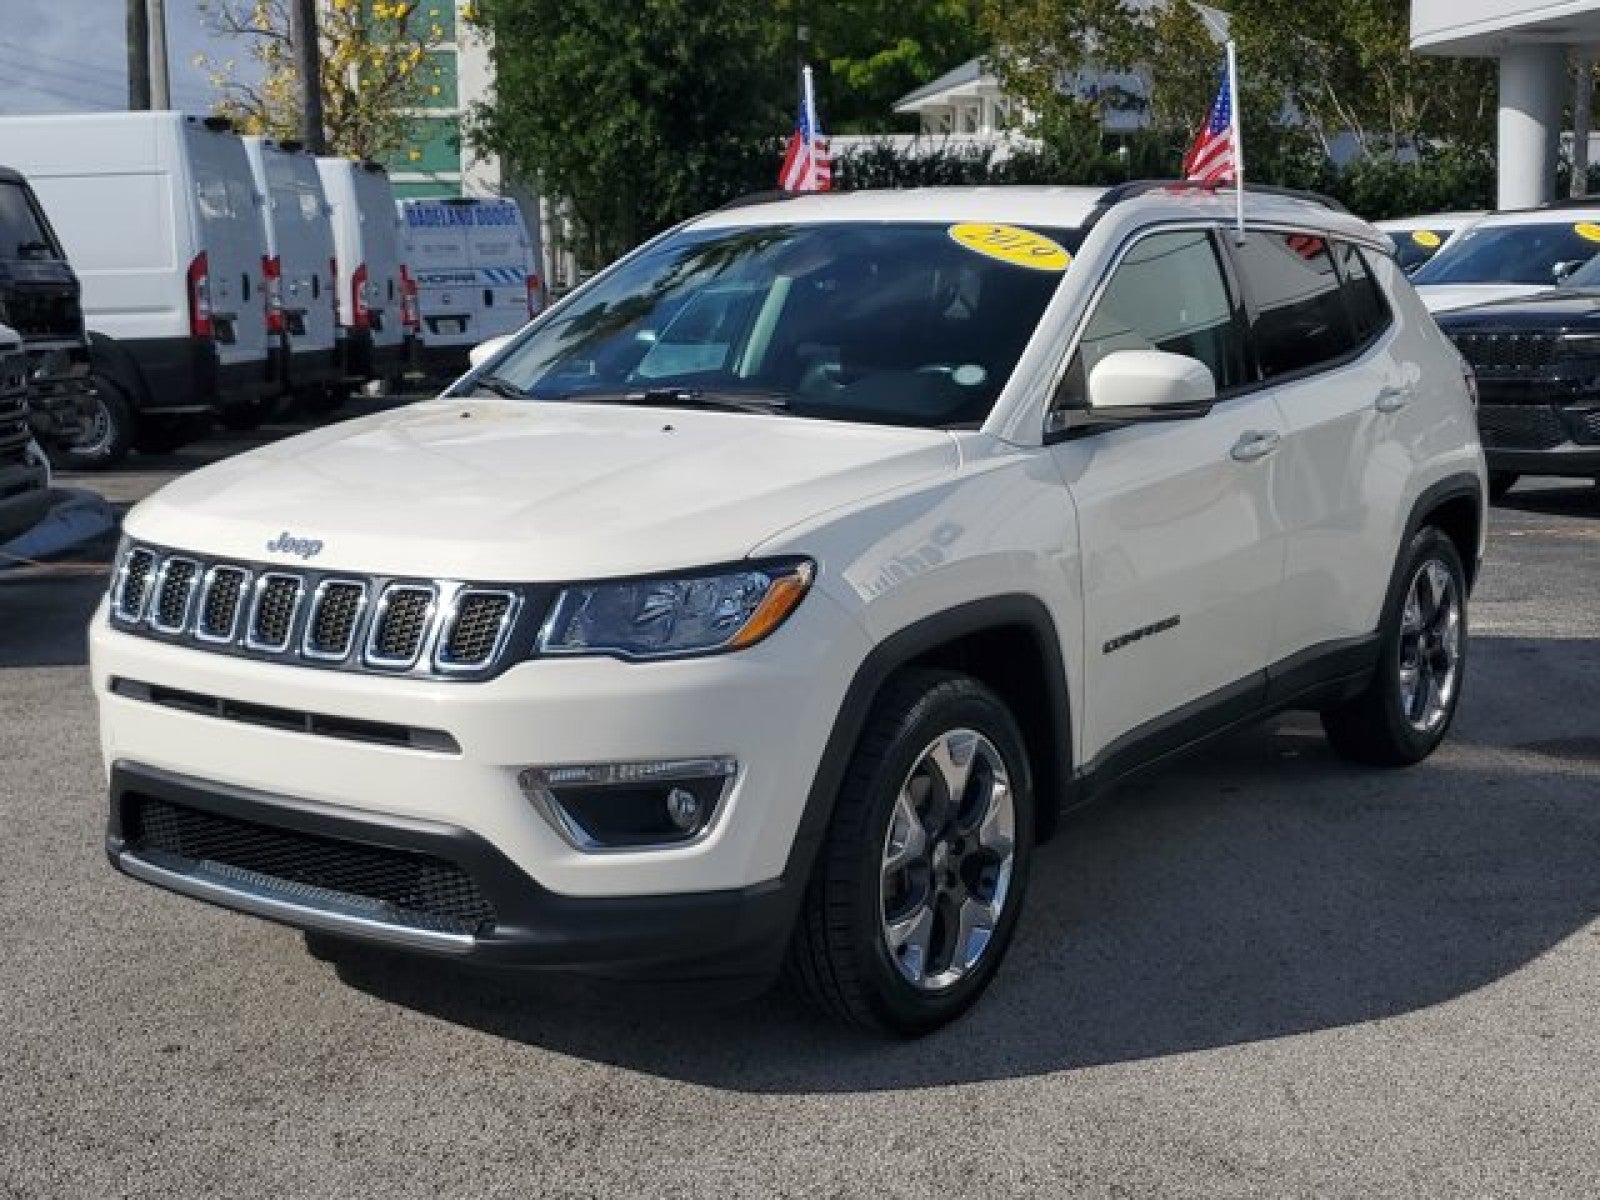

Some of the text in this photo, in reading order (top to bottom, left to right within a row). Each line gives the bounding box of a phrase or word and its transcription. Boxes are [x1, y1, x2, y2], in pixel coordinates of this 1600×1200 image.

[476, 206, 518, 226] DODGE
[961, 227, 1059, 256] 2019
[267, 531, 323, 560] Jeep
